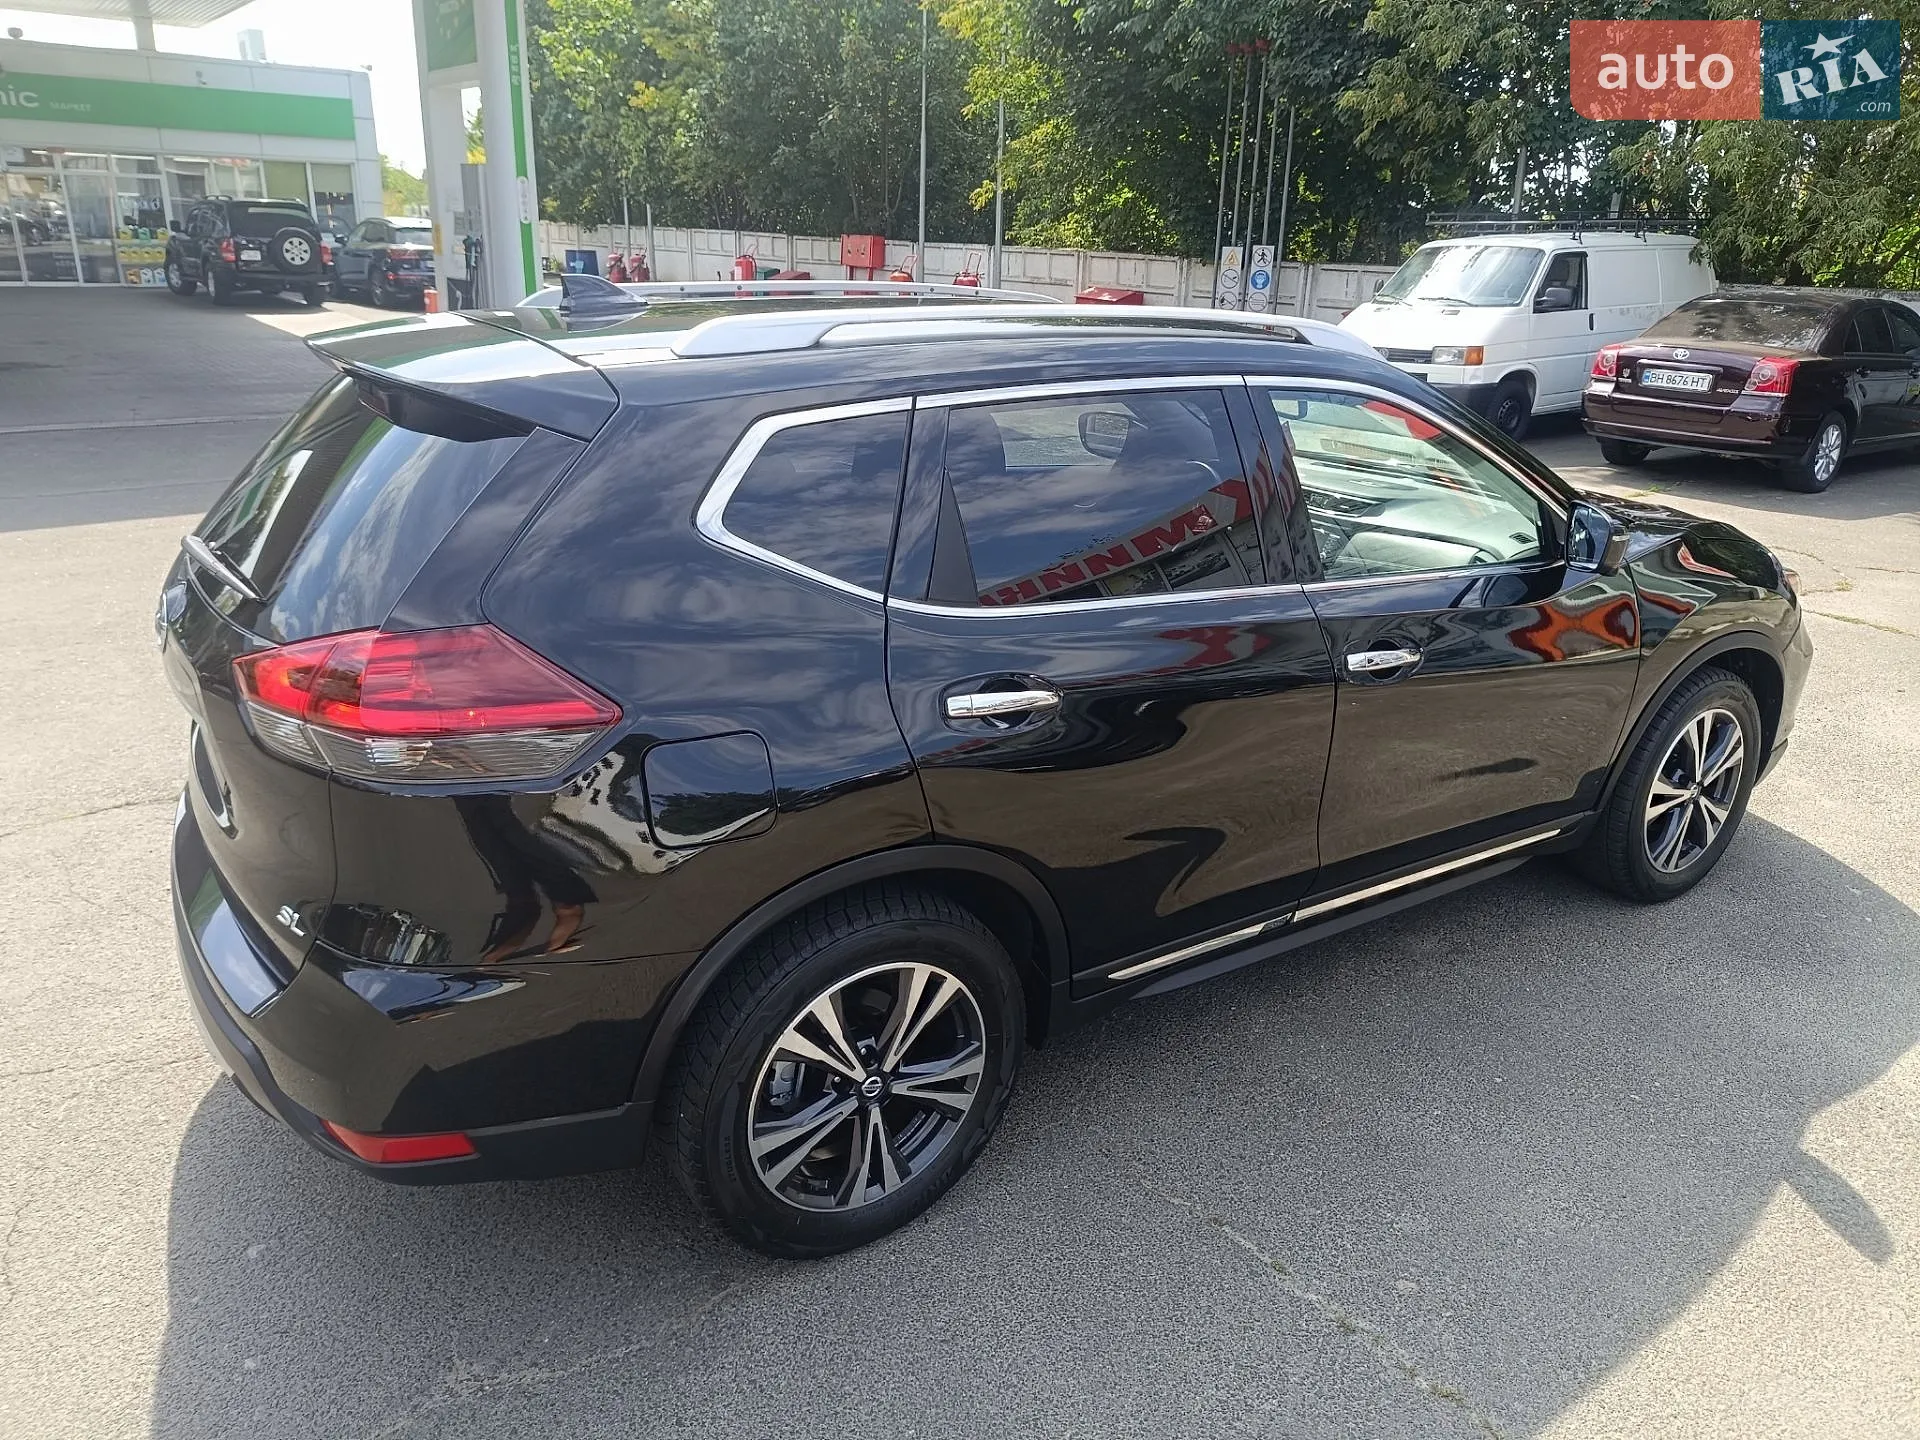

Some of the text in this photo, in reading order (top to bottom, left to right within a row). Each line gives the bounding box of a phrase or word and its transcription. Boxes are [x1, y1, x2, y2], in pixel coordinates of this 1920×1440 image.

[1649, 372, 1707, 388] BH 8676 HT
[276, 905, 305, 937] SL
